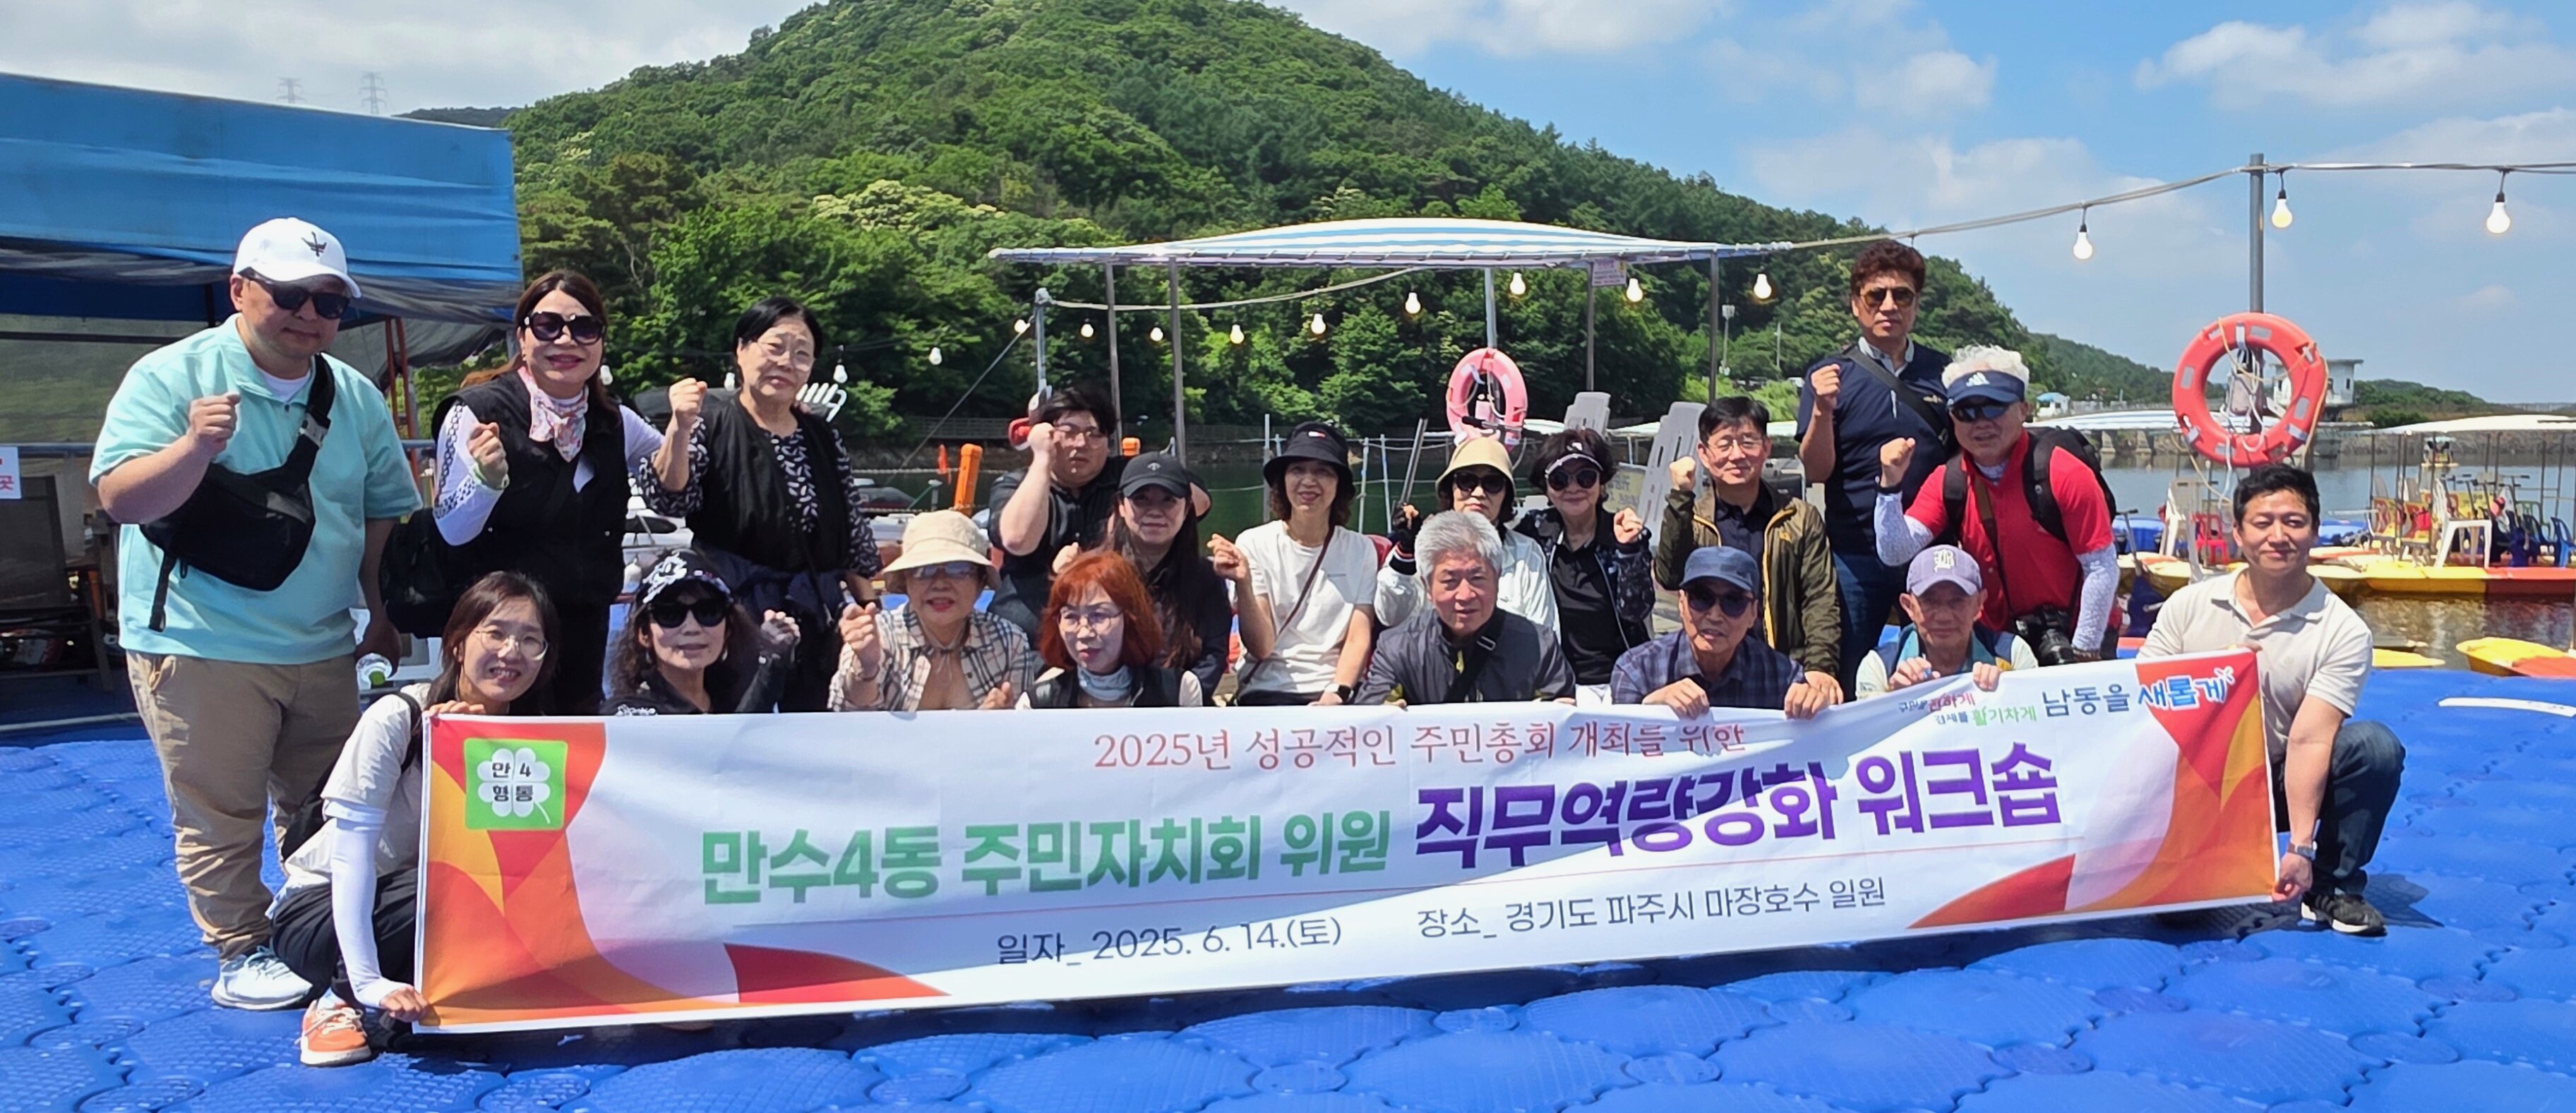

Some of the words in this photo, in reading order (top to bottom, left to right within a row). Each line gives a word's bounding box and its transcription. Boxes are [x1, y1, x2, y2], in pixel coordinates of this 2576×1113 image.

[1972, 706, 2037, 726] 활기차게
[2042, 683, 2131, 717] 남동을
[2137, 673, 2230, 709] 새롭게
[1094, 728, 1231, 771] 2025년
[1245, 725, 1396, 770] 성공적인
[1410, 721, 1555, 764] 주민총회
[1567, 721, 1667, 757] 개최를
[1678, 723, 1747, 753] 위한
[702, 824, 942, 905] 만수4동
[961, 814, 1262, 896] 주민자치회
[1279, 810, 1391, 877] 위원
[1415, 761, 1839, 870] 직무역량강화
[1855, 741, 2062, 836] 워크숍
[1417, 907, 1498, 939] 장소_
[1505, 898, 1598, 932] 경기도
[1606, 890, 1695, 925] 파주시
[1705, 882, 1821, 918] 마장호수
[1828, 876, 1886, 909] 일원
[997, 932, 1082, 966] 일자_
[1092, 927, 1192, 960] 2025.
[1202, 925, 1231, 953] 6.
[1240, 916, 1343, 950] 14.(토)
